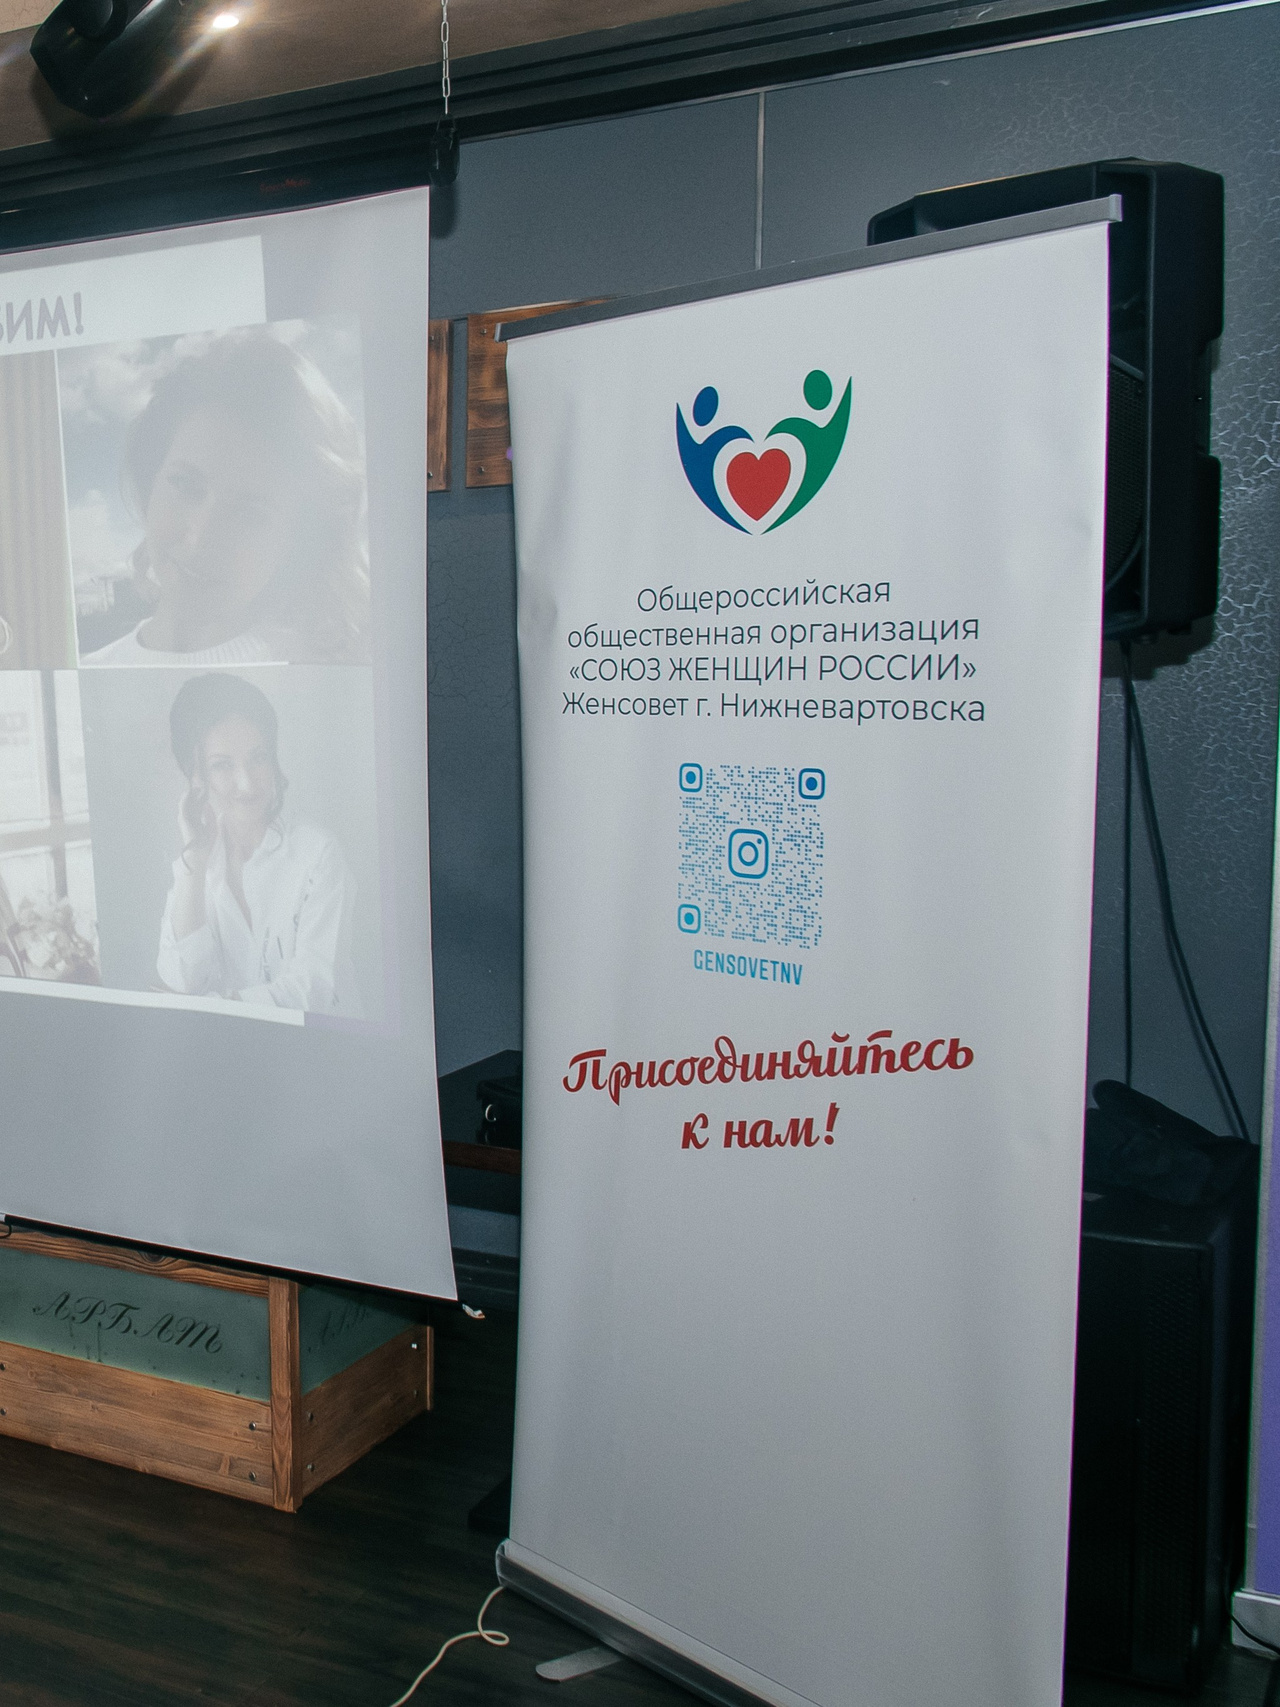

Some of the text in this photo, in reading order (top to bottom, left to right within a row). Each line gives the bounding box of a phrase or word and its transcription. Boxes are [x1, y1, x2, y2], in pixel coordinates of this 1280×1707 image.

[637, 578, 891, 615] Общероссийская
[567, 616, 980, 651] общественная организация
[569, 653, 977, 686] «СОЮЗ ЖЕНЩИН РОССИИ»
[562, 691, 986, 726] Женсовет г. Нижневартовска
[693, 949, 803, 986] GENSOVETNV
[562, 1029, 974, 1106] Присоединяйтесь
[681, 1102, 840, 1150] к нам!
